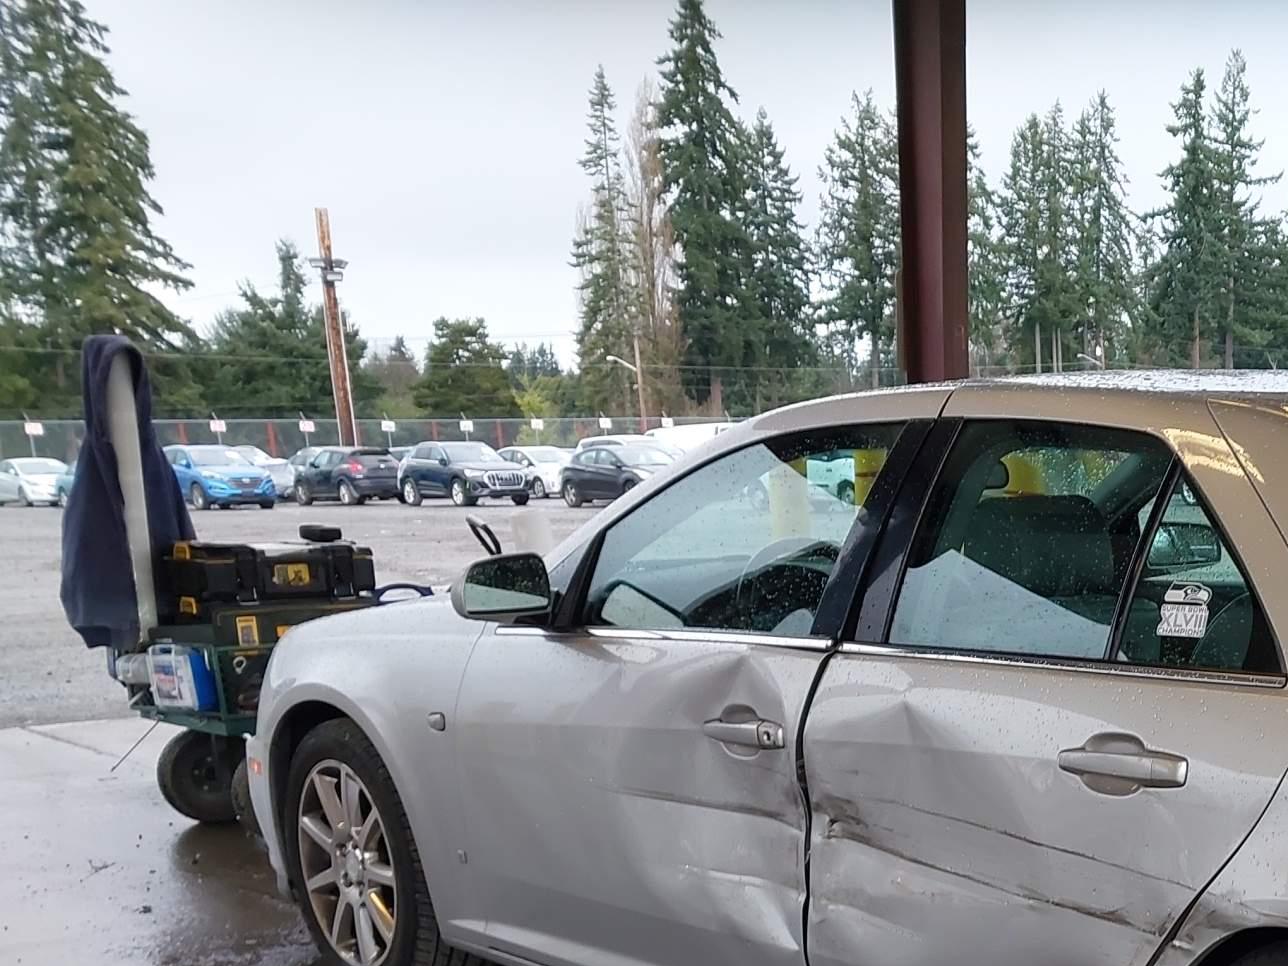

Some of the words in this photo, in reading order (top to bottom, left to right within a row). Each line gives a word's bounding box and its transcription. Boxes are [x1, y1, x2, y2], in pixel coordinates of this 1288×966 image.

[1162, 605, 1186, 613] SUPER
[1161, 612, 1207, 629] XLVIII
[1158, 627, 1204, 636] CHAMPIONS
